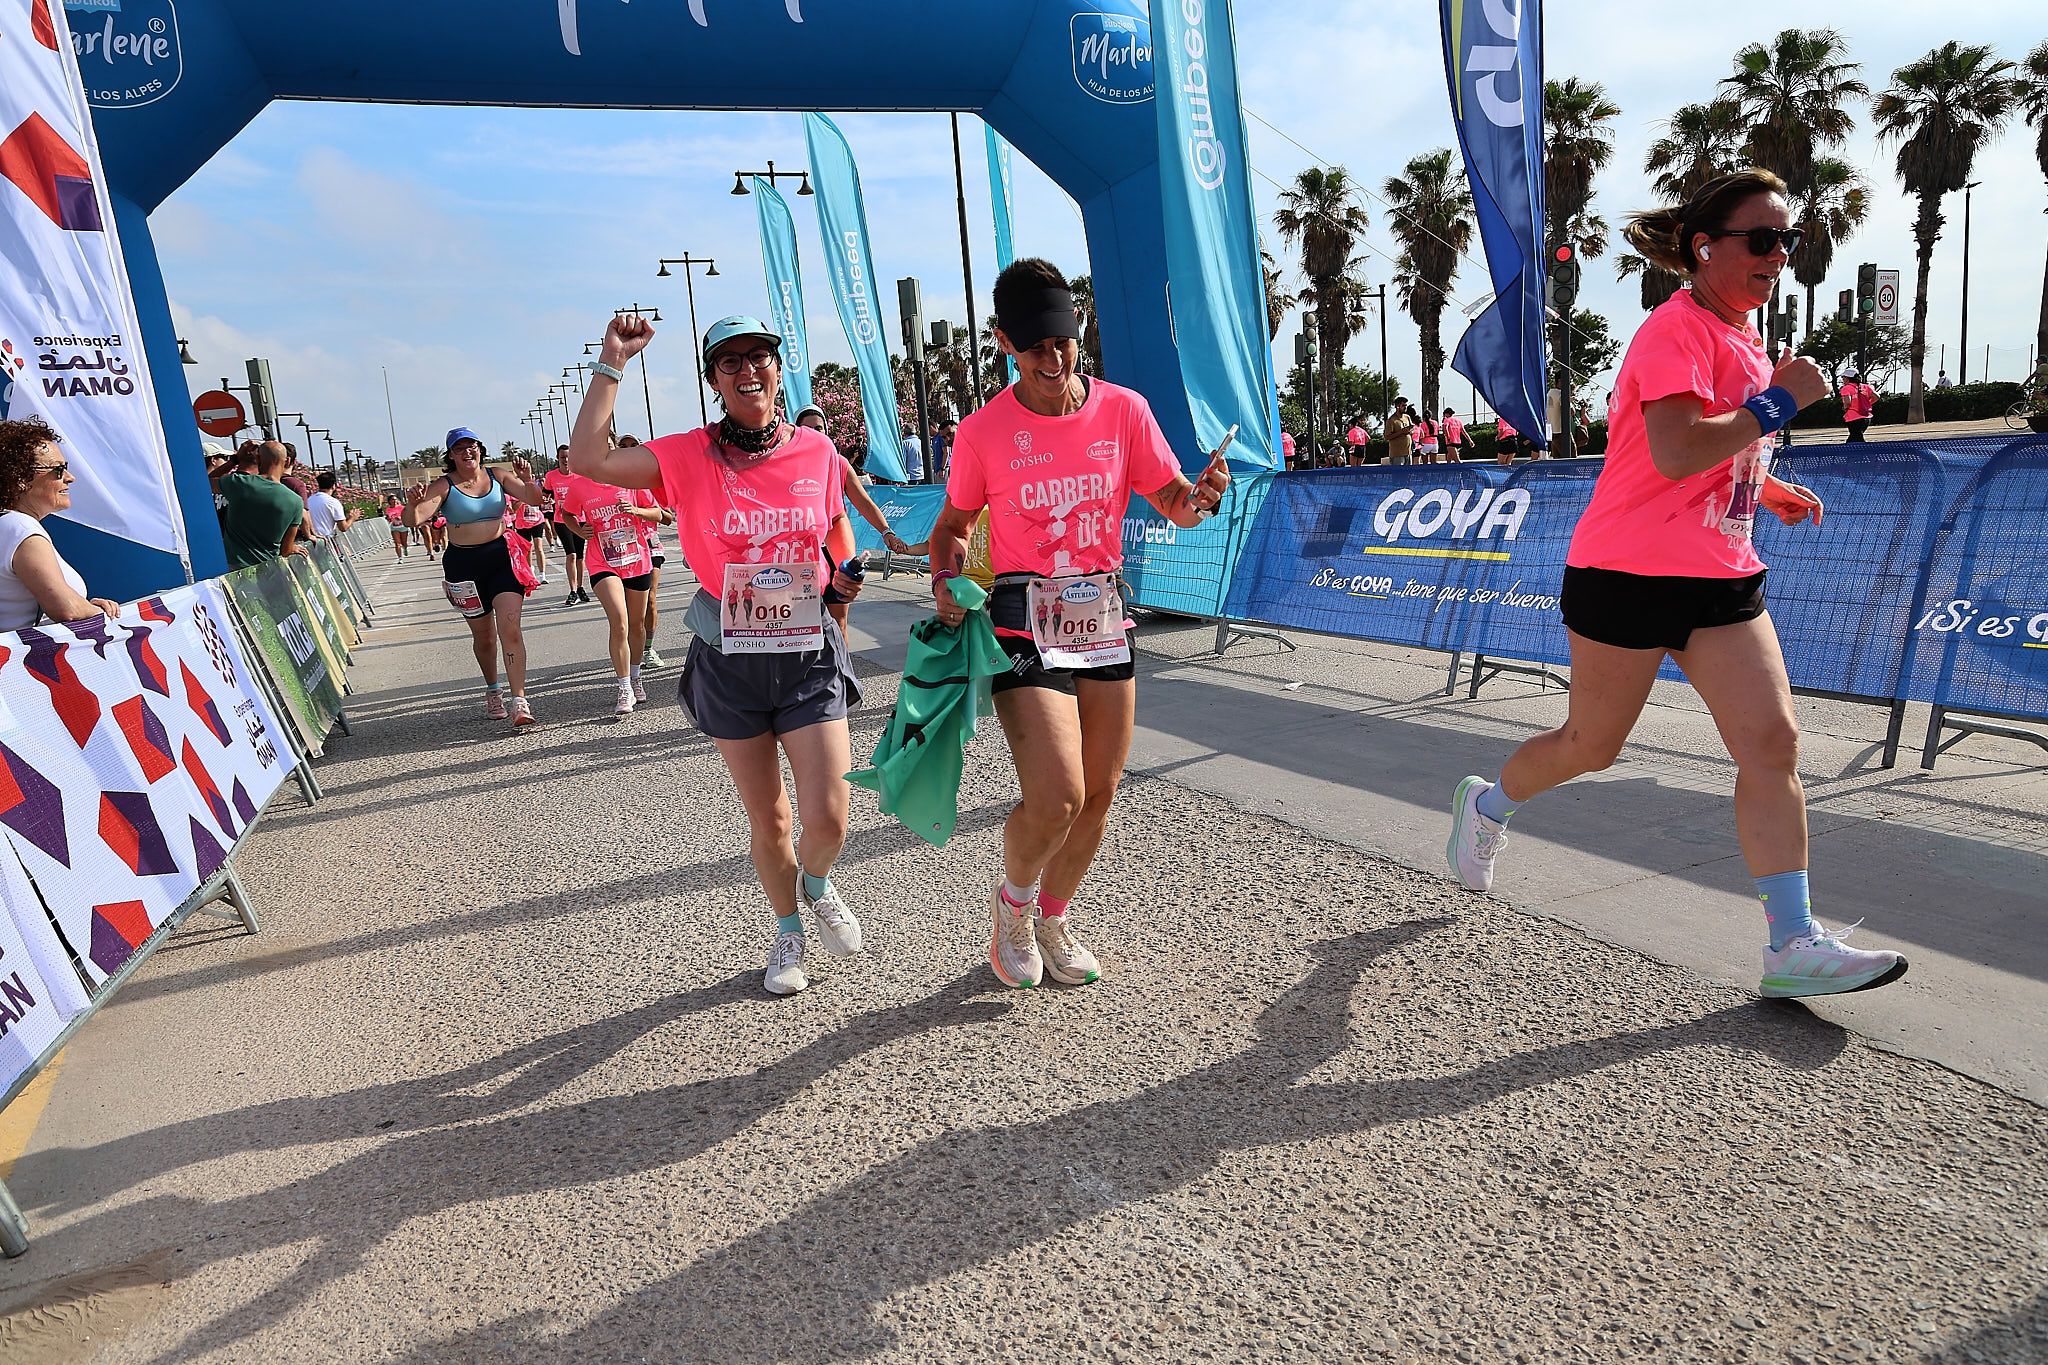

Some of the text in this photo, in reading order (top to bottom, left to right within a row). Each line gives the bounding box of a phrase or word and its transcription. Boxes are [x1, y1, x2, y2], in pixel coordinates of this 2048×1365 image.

[71, 14, 170, 65] arlene
[1081, 33, 1153, 79] Marlen
[93, 89, 120, 100] LOS
[125, 79, 162, 100] ALPES
[1087, 78, 1141, 98] HIJA DE LOS
[1881, 293, 1892, 302] 30
[1010, 453, 1053, 470] OYSHO
[1020, 472, 1113, 510] CARRERA
[723, 507, 816, 535] CARRERA
[1373, 488, 1530, 543] GOYA
[1121, 517, 1176, 549] mpeed
[755, 575, 790, 586] ASTURIANA
[1065, 591, 1099, 599] ASTURIANA
[1333, 577, 1350, 589] es
[1350, 575, 1393, 593] GOYA
[1437, 586, 1465, 612] que
[1469, 588, 1500, 602] ser
[755, 604, 792, 620] 016
[1063, 618, 1098, 635] 016
[1977, 617, 2021, 637] es
[784, 640, 813, 648] Santander
[1090, 653, 1119, 662] Santander
[0, 971, 36, 1040] AN
